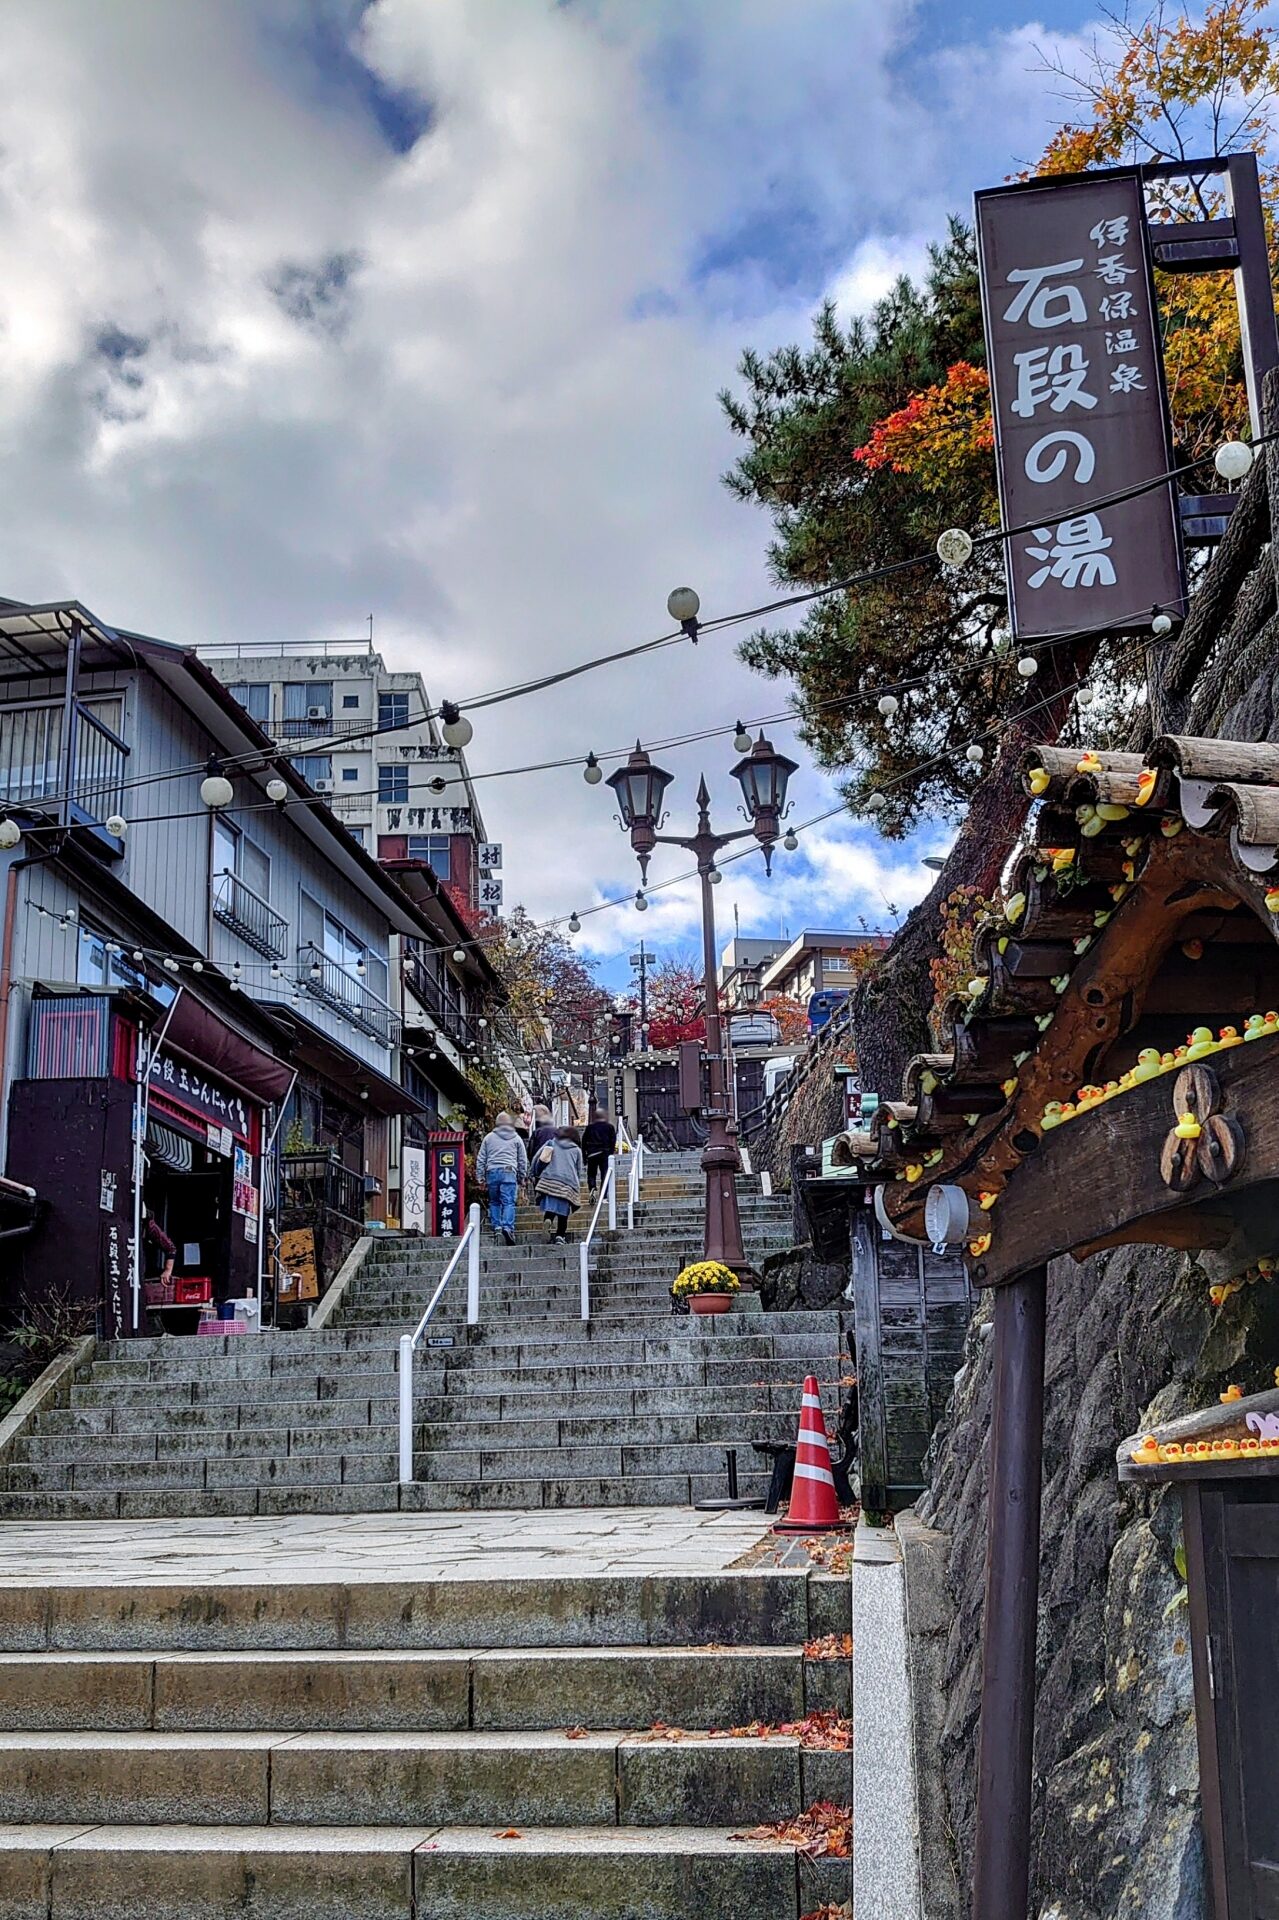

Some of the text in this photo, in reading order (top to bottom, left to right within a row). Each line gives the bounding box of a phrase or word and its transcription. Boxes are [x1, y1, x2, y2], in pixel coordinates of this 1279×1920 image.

[1090, 215, 1147, 394] 伊香保温泉
[1003, 258, 1117, 589] 石段の湯
[481, 846, 500, 901] 村松
[438, 1167, 457, 1204] 小路
